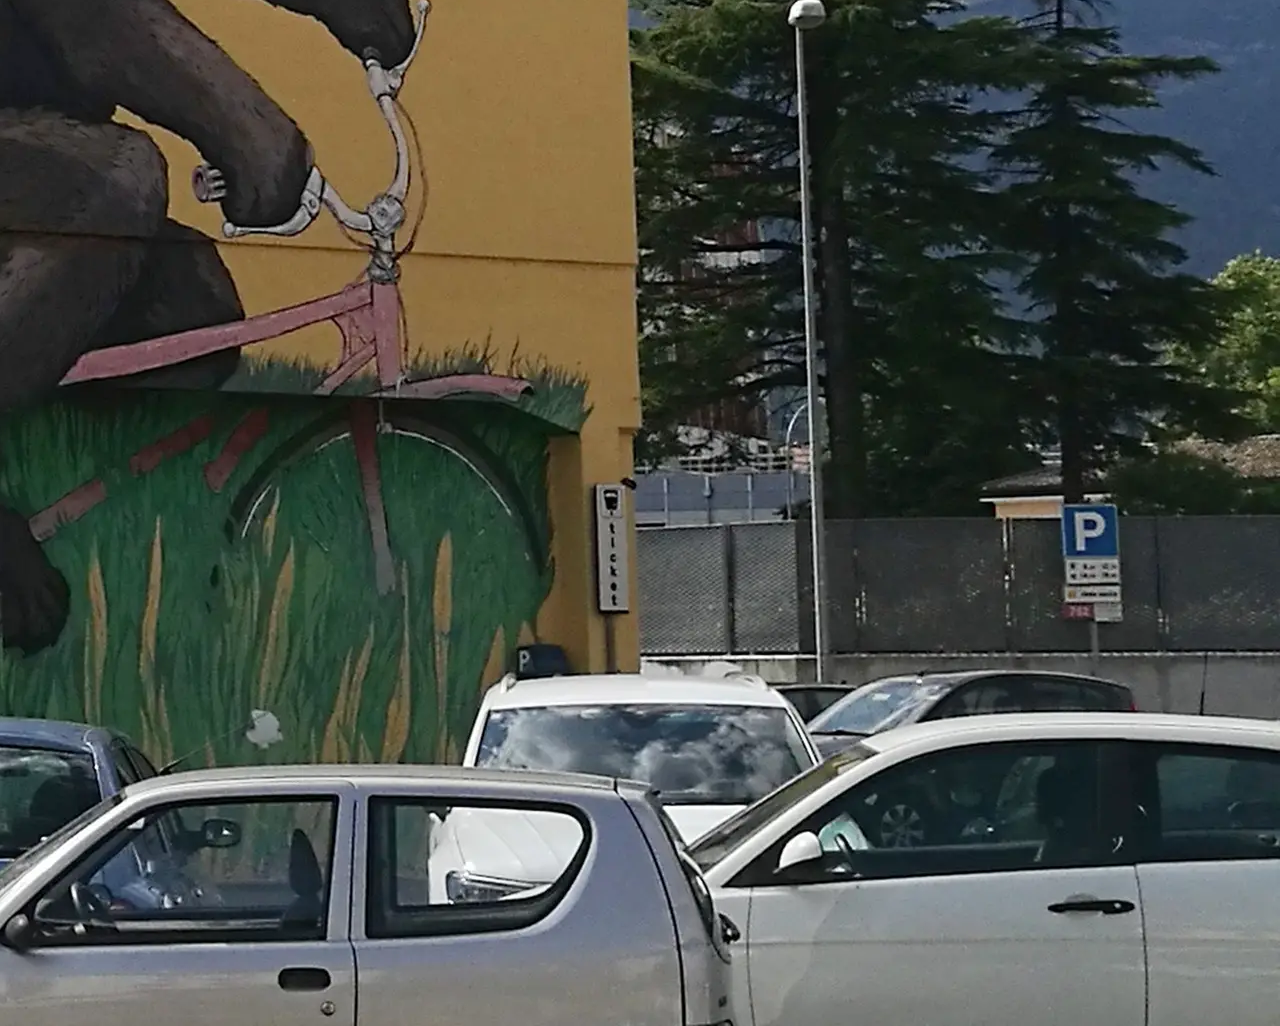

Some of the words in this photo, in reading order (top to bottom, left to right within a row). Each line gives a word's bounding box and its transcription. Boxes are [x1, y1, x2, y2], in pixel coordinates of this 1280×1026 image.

[1074, 512, 1106, 551] P
[609, 522, 618, 607] ticket
[519, 650, 531, 672] P
